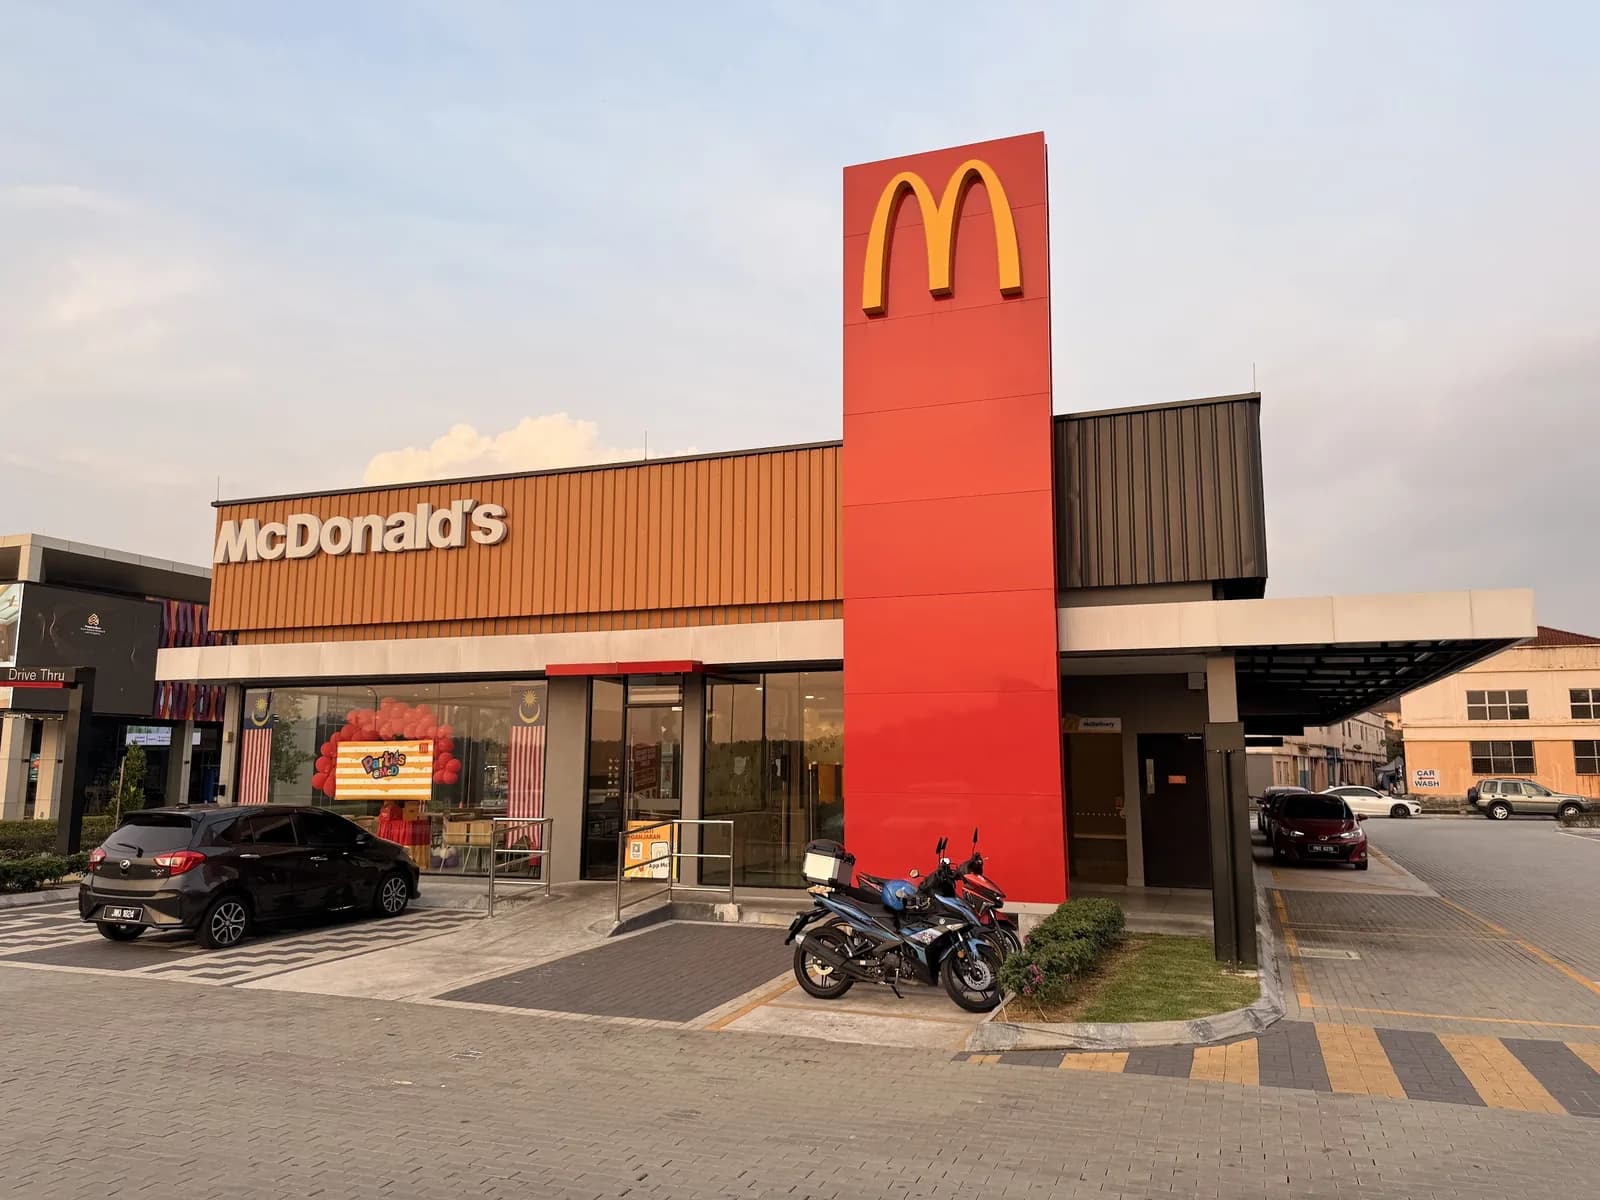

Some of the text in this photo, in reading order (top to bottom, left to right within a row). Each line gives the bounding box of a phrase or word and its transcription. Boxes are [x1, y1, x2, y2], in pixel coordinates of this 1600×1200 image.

[213, 499, 507, 564] McDonald's
[8, 668, 65, 681] Drive Thru
[361, 749, 406, 774] Parties
[372, 764, 399, 779] @McD
